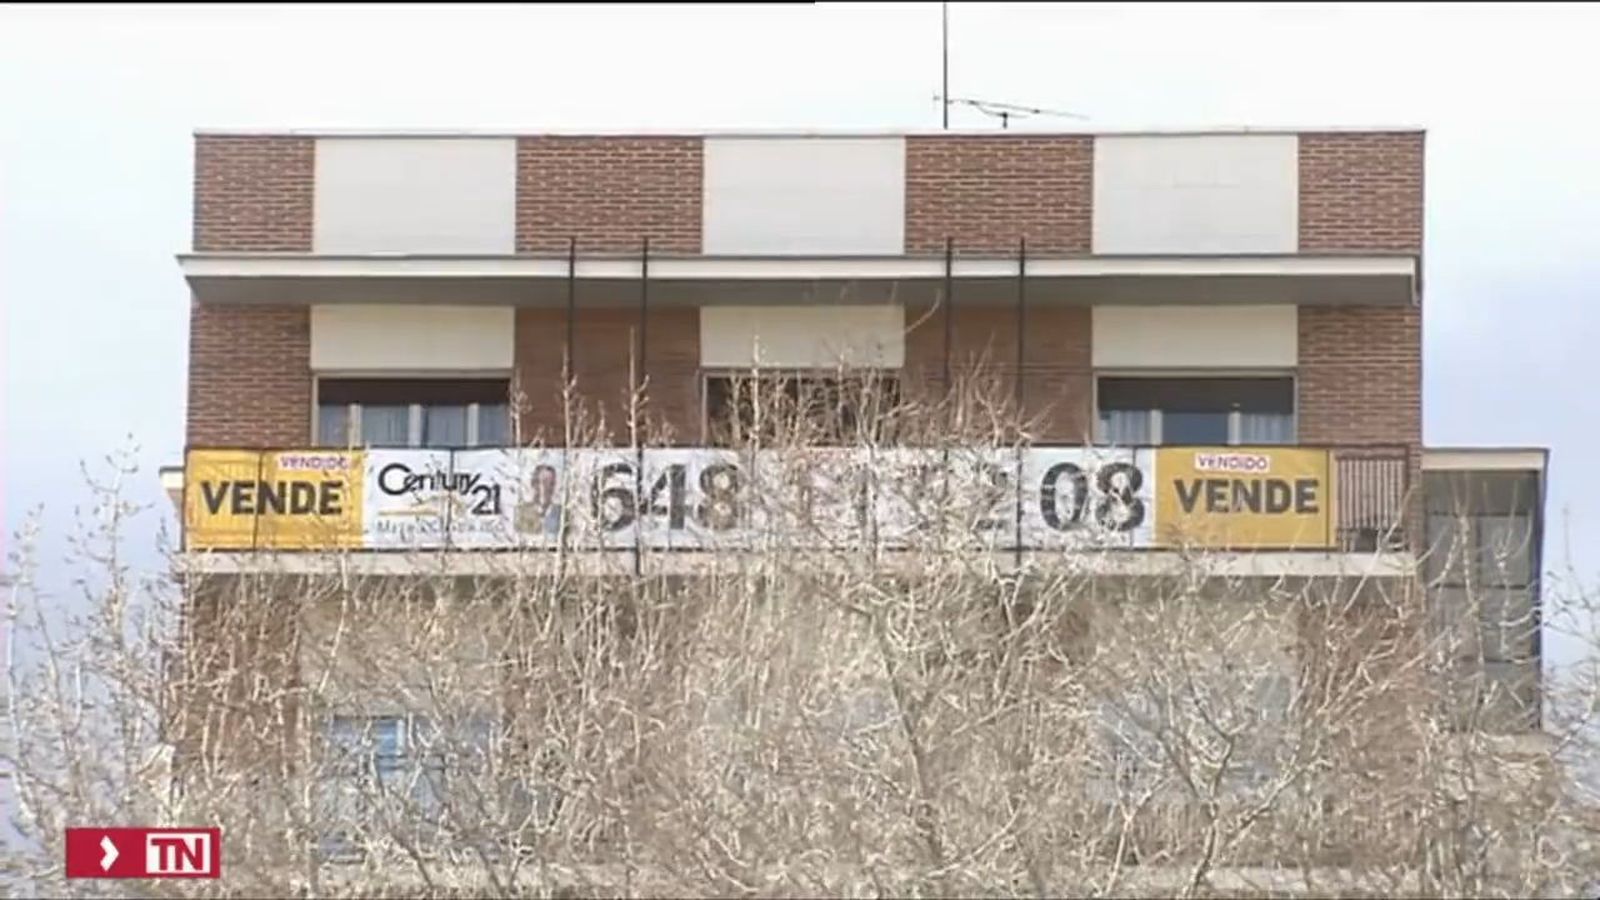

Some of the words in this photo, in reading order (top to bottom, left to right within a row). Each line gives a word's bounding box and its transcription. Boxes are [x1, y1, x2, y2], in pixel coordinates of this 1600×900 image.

[377, 462, 478, 495] Century
[1198, 455, 1268, 470] VENDIDO
[200, 480, 344, 516] VENDE
[470, 485, 501, 515] 21
[591, 463, 738, 531] 648
[1040, 462, 1145, 532] 08
[1173, 479, 1320, 514] VENDE
